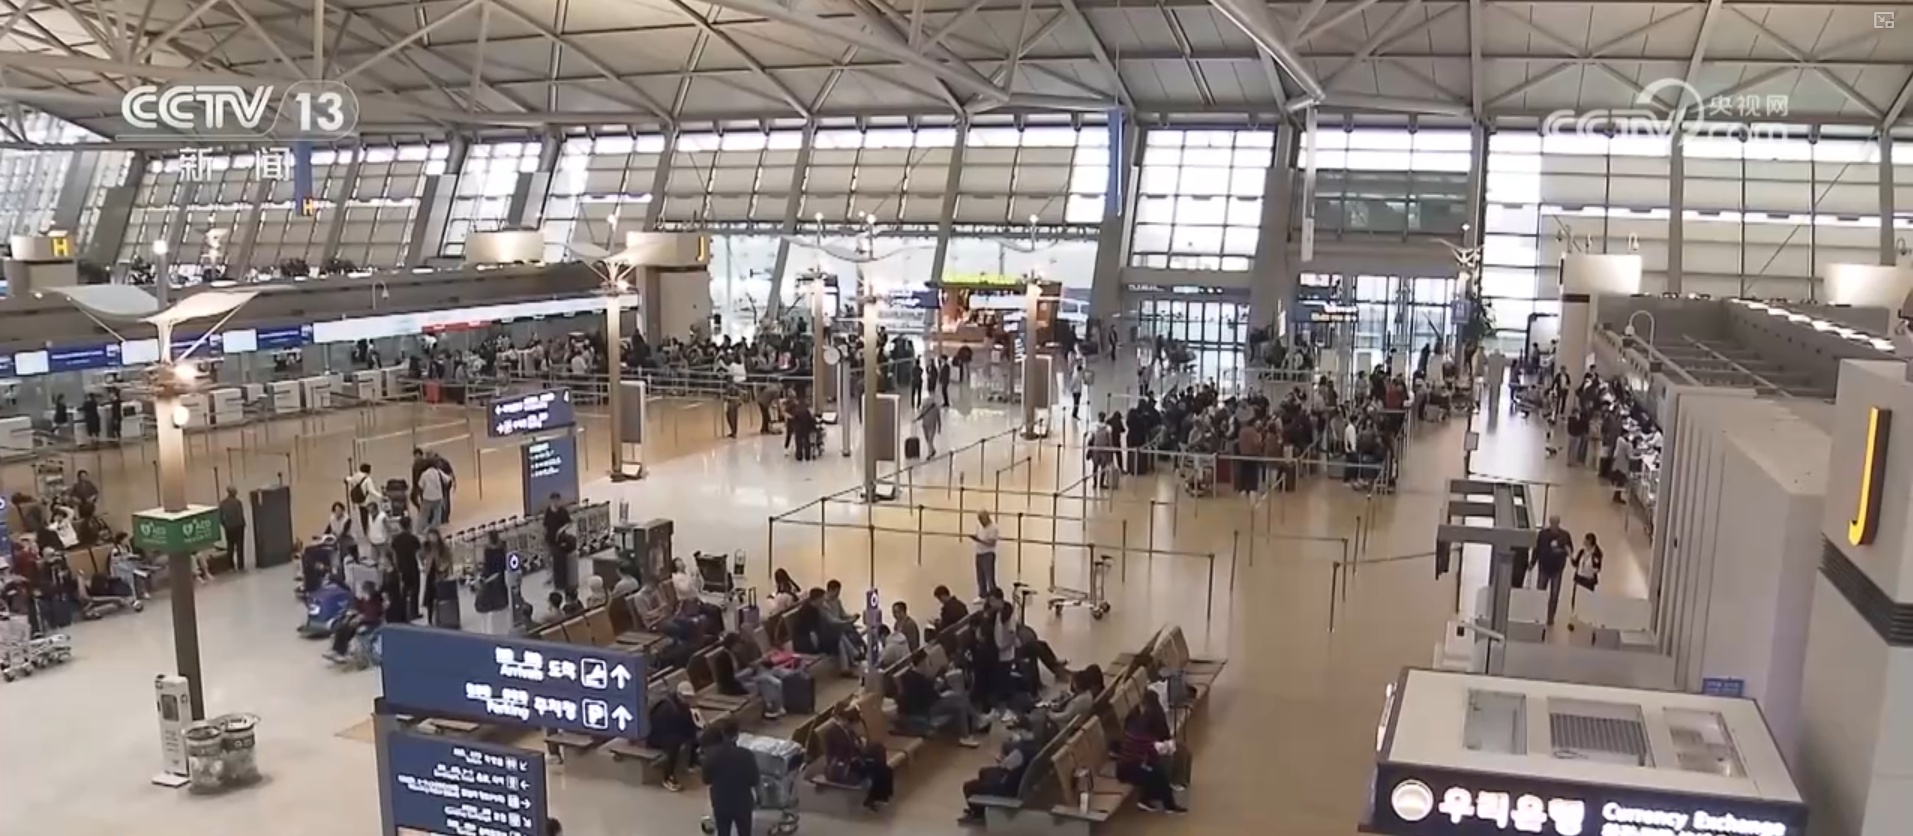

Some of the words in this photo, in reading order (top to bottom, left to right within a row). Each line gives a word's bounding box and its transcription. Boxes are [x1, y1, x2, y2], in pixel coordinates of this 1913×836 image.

[302, 197, 314, 216] H
[52, 238, 69, 257] H
[696, 236, 705, 262] J
[1848, 404, 1884, 546] J
[1602, 801, 1690, 831] Currency
[1693, 810, 1787, 836] Exchange
